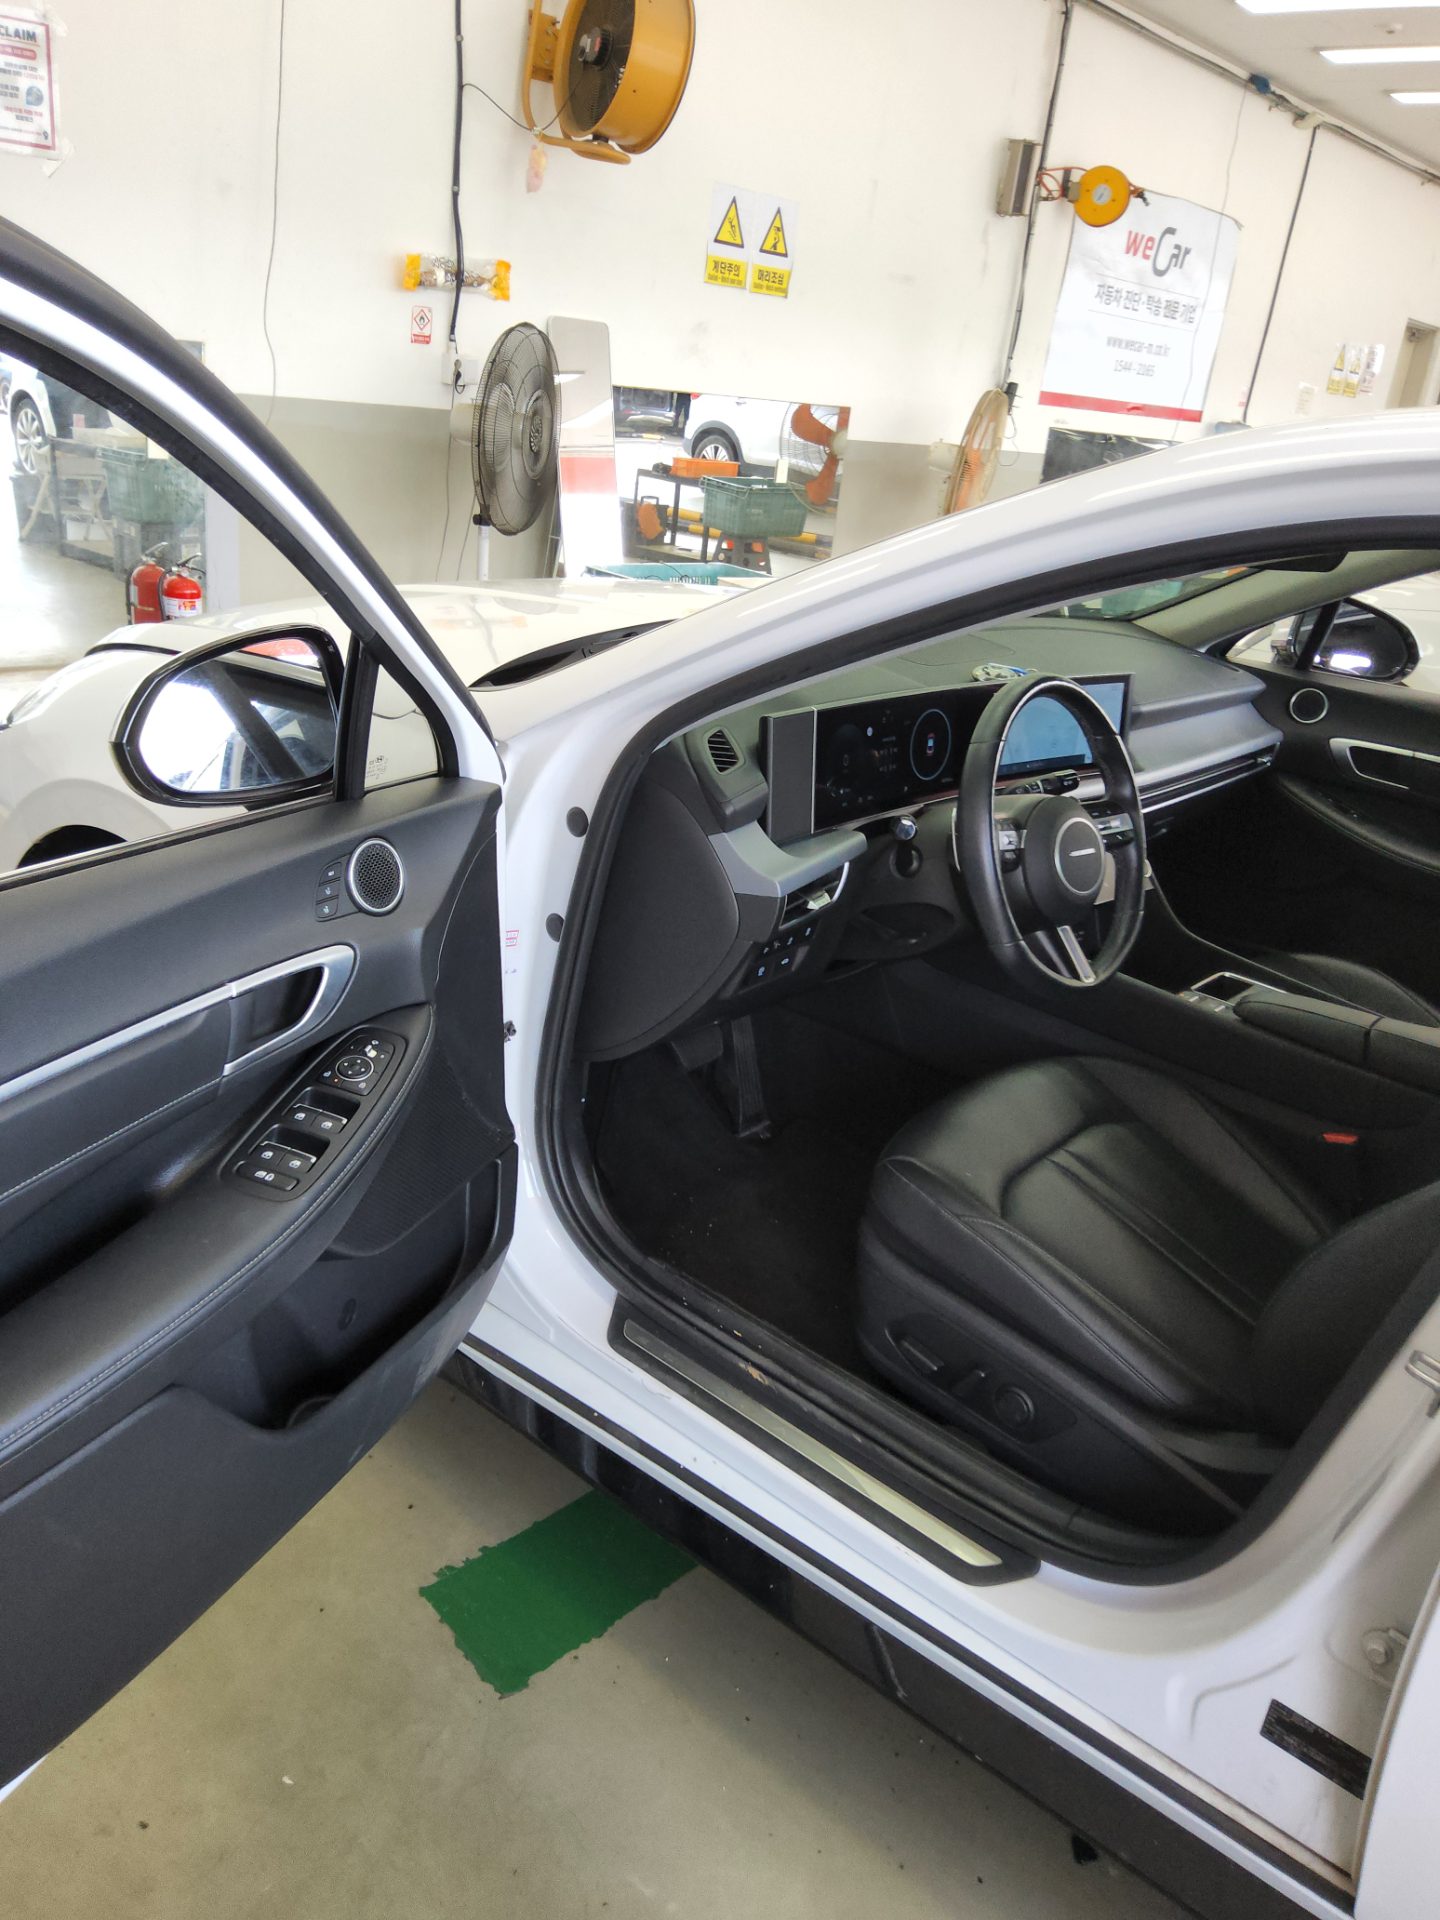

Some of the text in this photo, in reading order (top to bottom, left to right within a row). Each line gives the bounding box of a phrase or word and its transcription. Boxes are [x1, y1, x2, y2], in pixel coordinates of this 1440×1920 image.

[713, 260, 740, 277] 계단주의
[758, 269, 784, 285] 머리조심
[1095, 283, 1123, 307] 자동차
[1179, 303, 1198, 324] 기업
